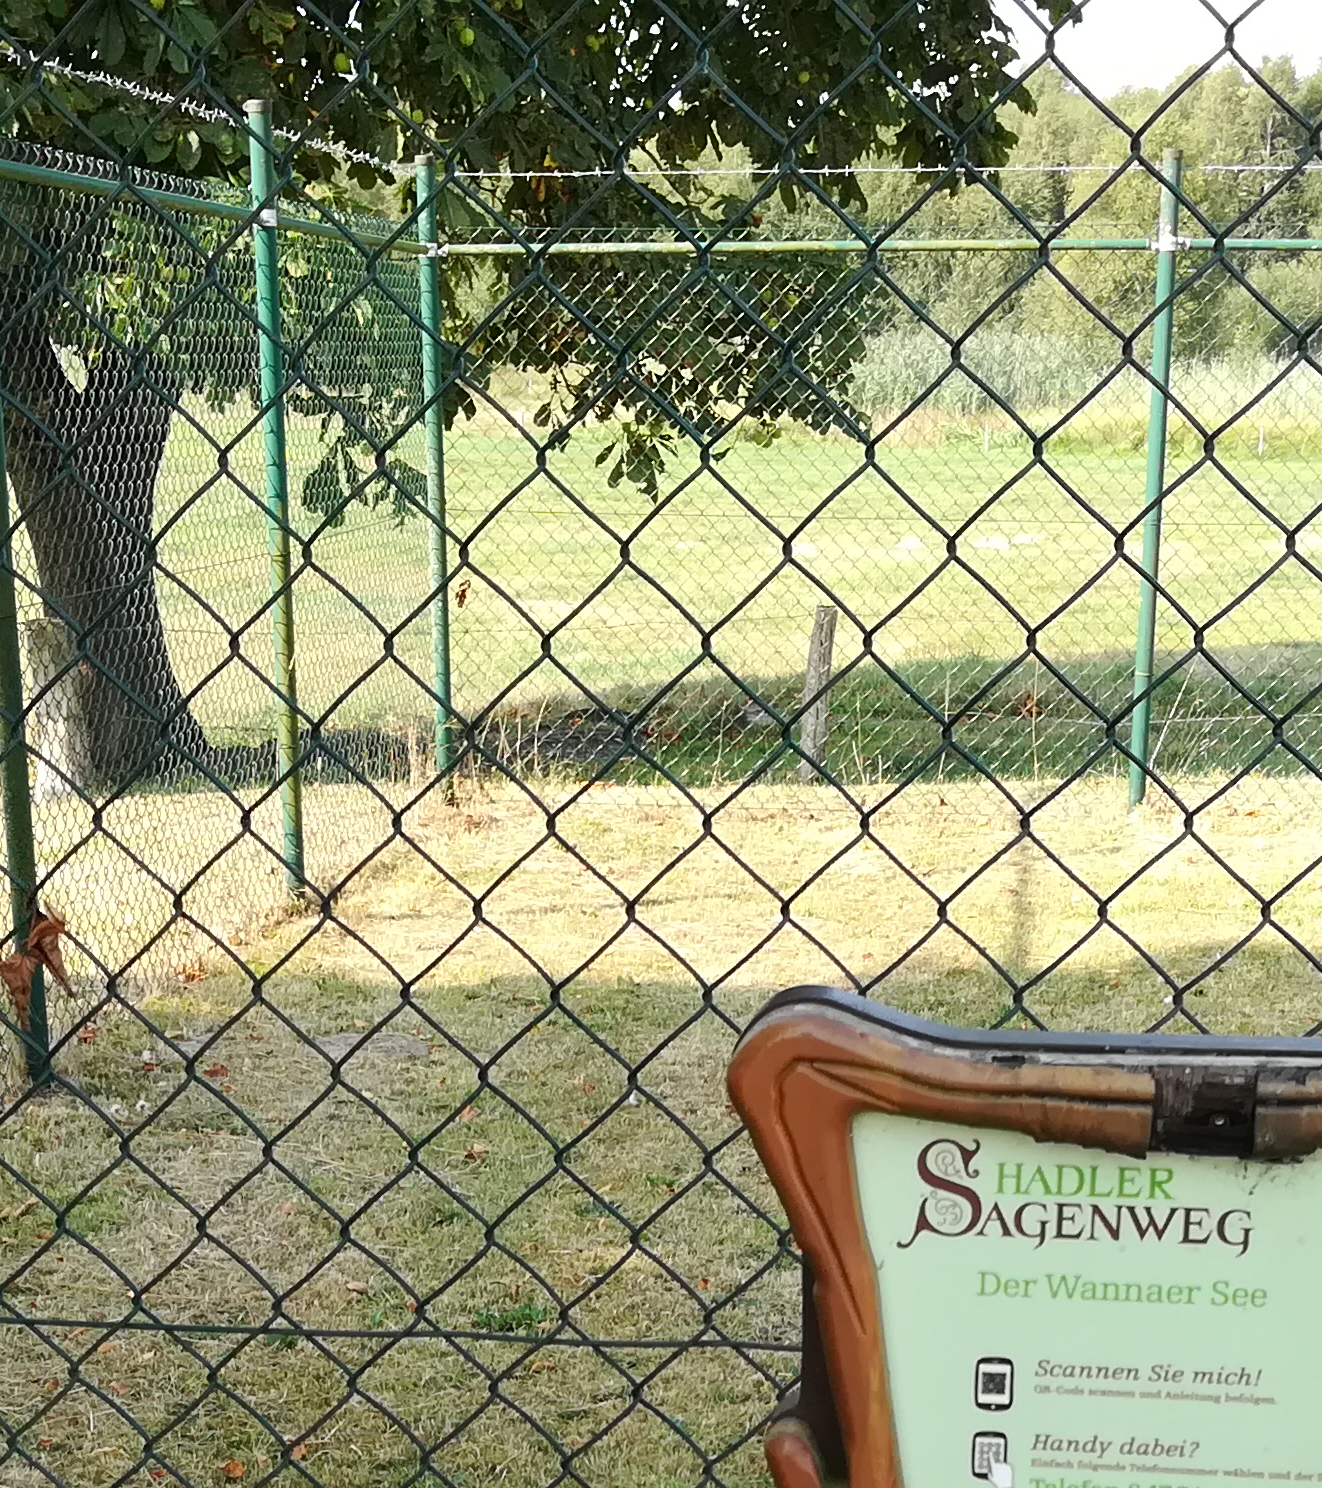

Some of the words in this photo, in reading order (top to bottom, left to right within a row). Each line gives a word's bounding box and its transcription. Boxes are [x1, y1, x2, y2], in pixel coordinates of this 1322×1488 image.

[995, 1162, 1176, 1200] HADLER
[896, 1138, 1254, 1257] SAGENWEG
[977, 1271, 1037, 1300] Der
[1045, 1274, 1202, 1306] Wannaer
[1210, 1280, 1268, 1309] See
[1034, 1359, 1141, 1381] Scannen
[1147, 1364, 1185, 1385] Sie
[1192, 1366, 1263, 1387] mich!
[1088, 1388, 1136, 1399] scannen
[1139, 1390, 1162, 1400] und
[1031, 1434, 1112, 1459] Handy
[1119, 1437, 1200, 1459] dabei?
[1031, 1458, 1074, 1469] Einfach
[1077, 1460, 1126, 1473] folgende
[1268, 1471, 1291, 1481] und
[1294, 1472, 1314, 1482] der
